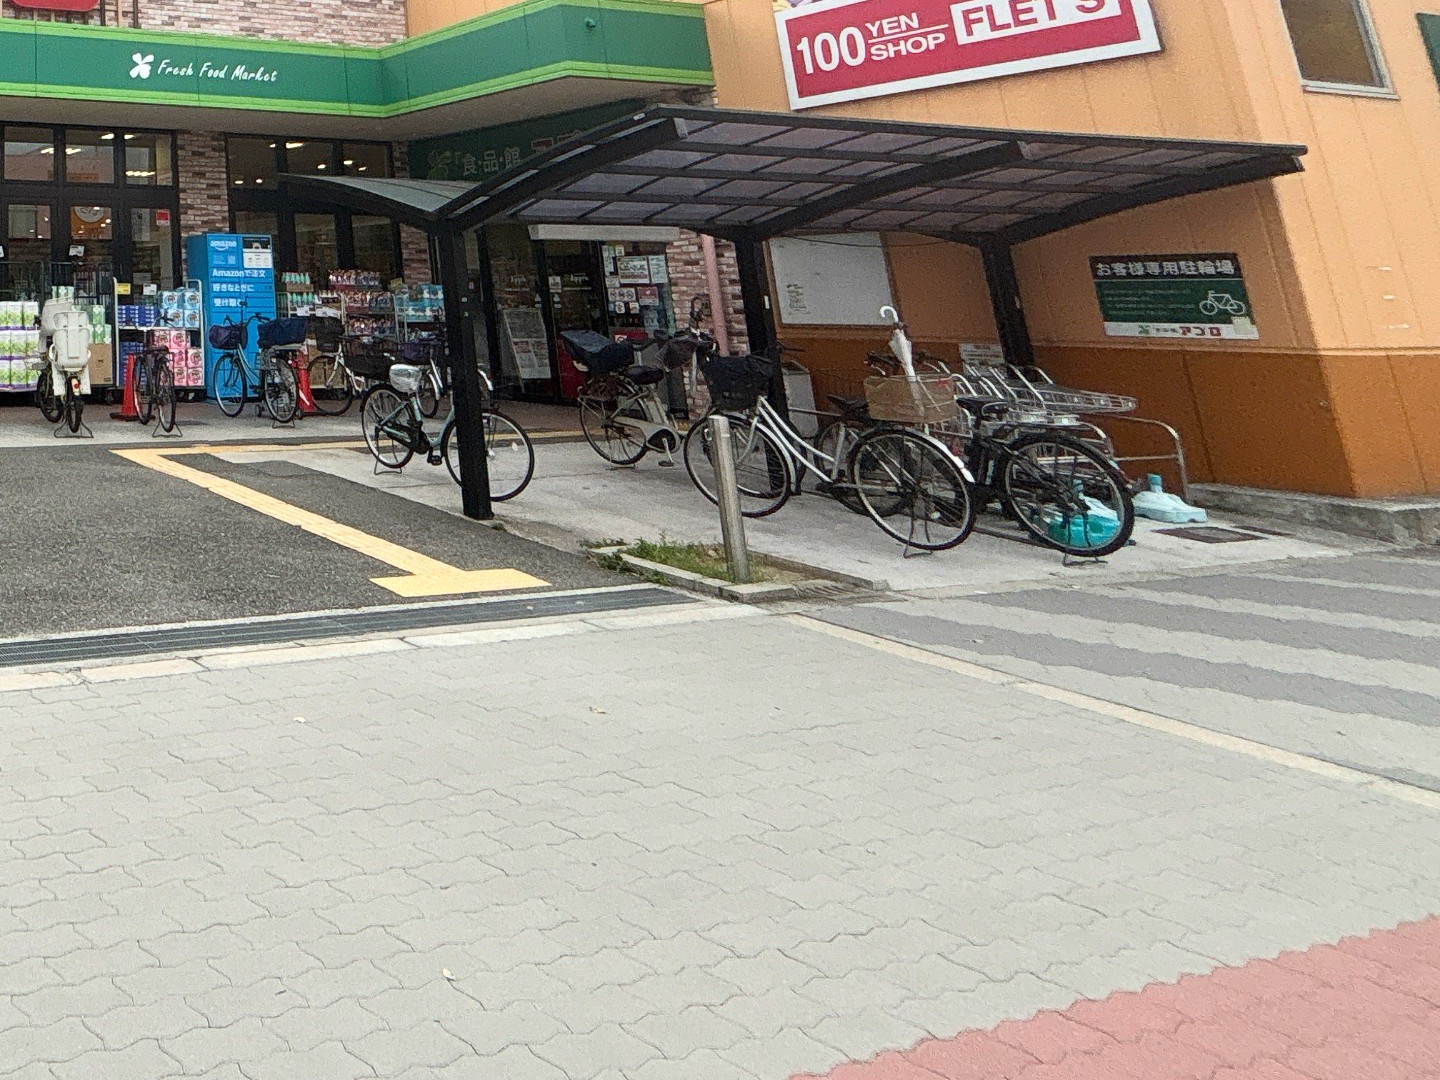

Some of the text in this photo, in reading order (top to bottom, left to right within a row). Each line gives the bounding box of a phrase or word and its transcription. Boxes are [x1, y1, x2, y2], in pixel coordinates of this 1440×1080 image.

[865, 12, 920, 38] YEN
[797, 27, 865, 73] 100
[870, 33, 945, 61] SHOP
[157, 59, 278, 82] Fresh Food Market
[210, 240, 237, 248] amazon
